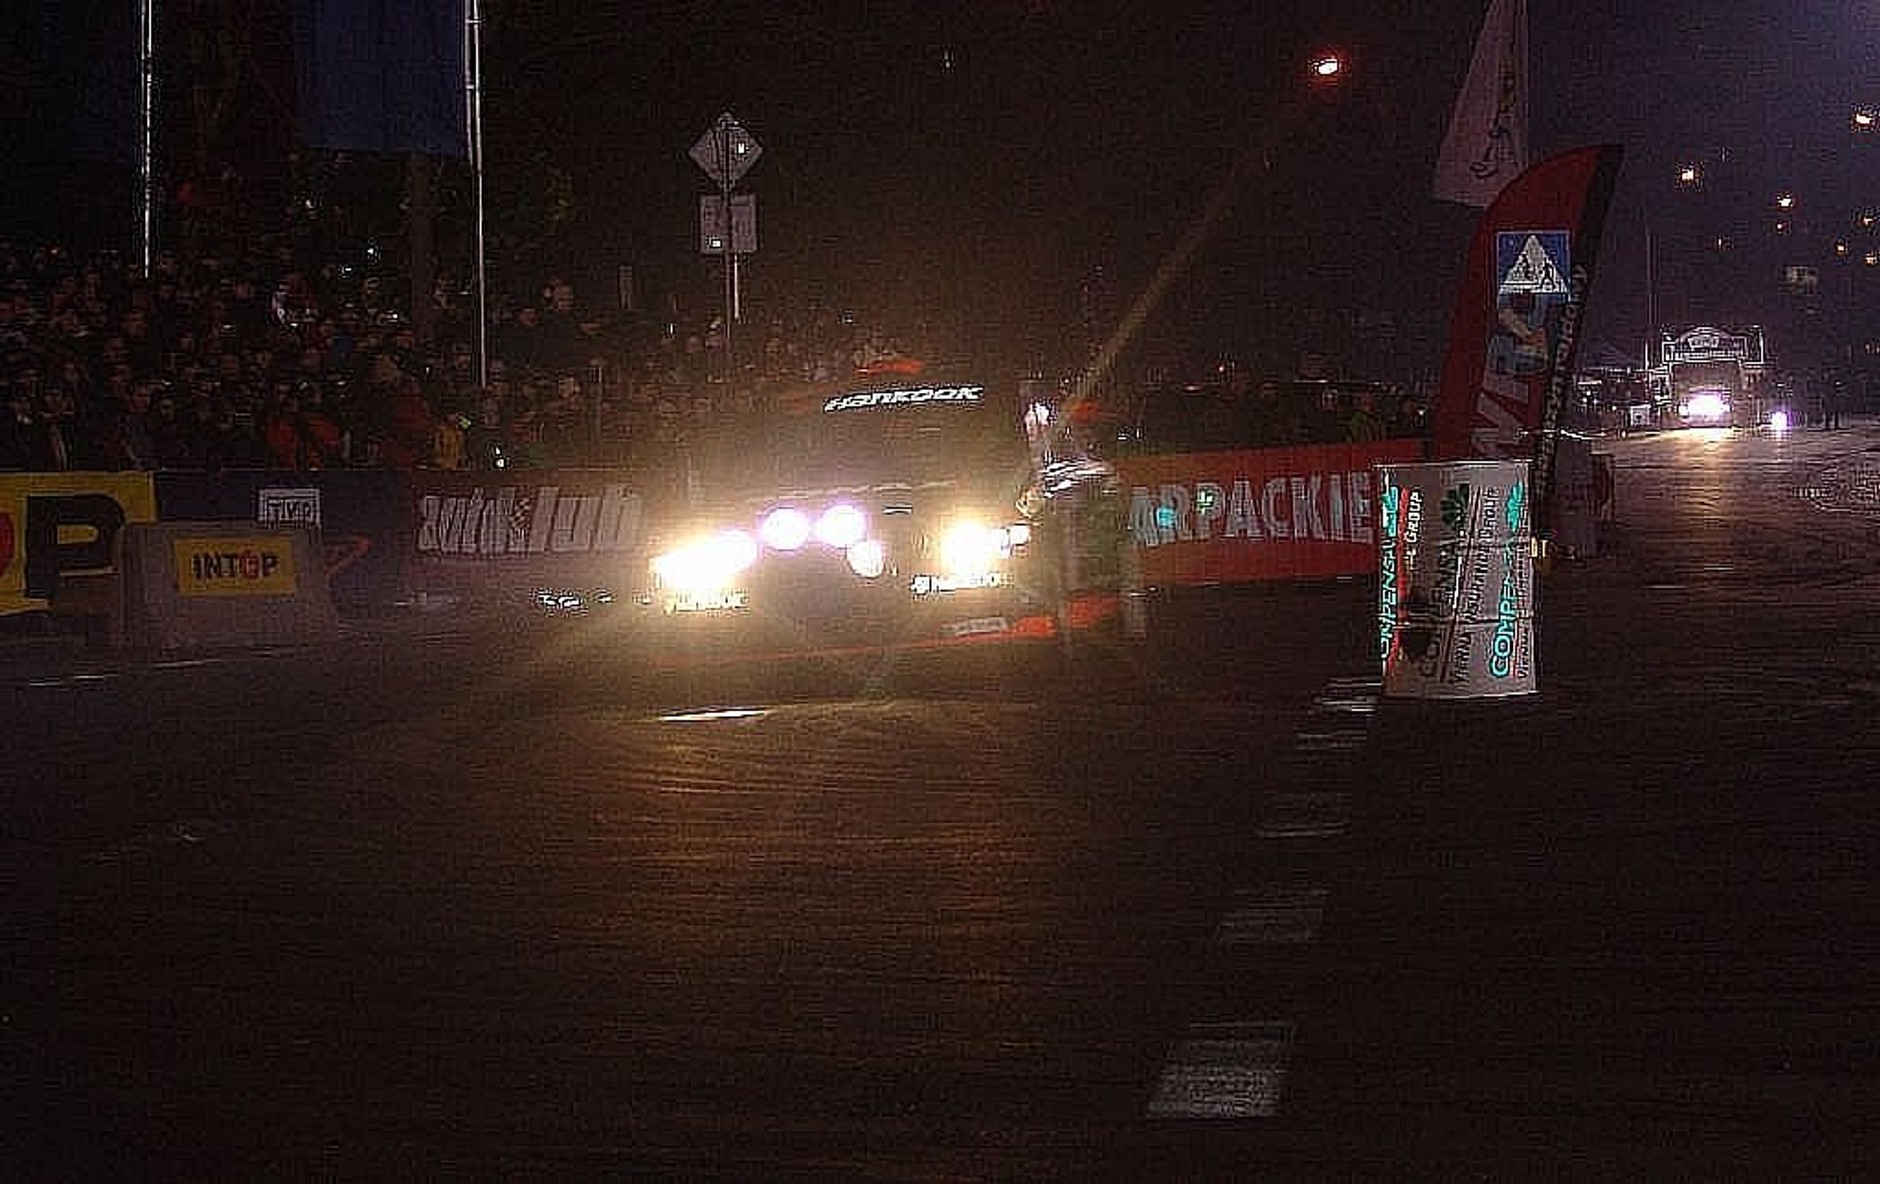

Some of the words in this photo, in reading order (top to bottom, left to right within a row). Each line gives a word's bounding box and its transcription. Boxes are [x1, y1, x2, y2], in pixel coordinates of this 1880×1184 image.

[1555, 264, 1588, 371] rajdowy
[1405, 490, 1422, 543] GROUP
[191, 552, 280, 580] INTOP
